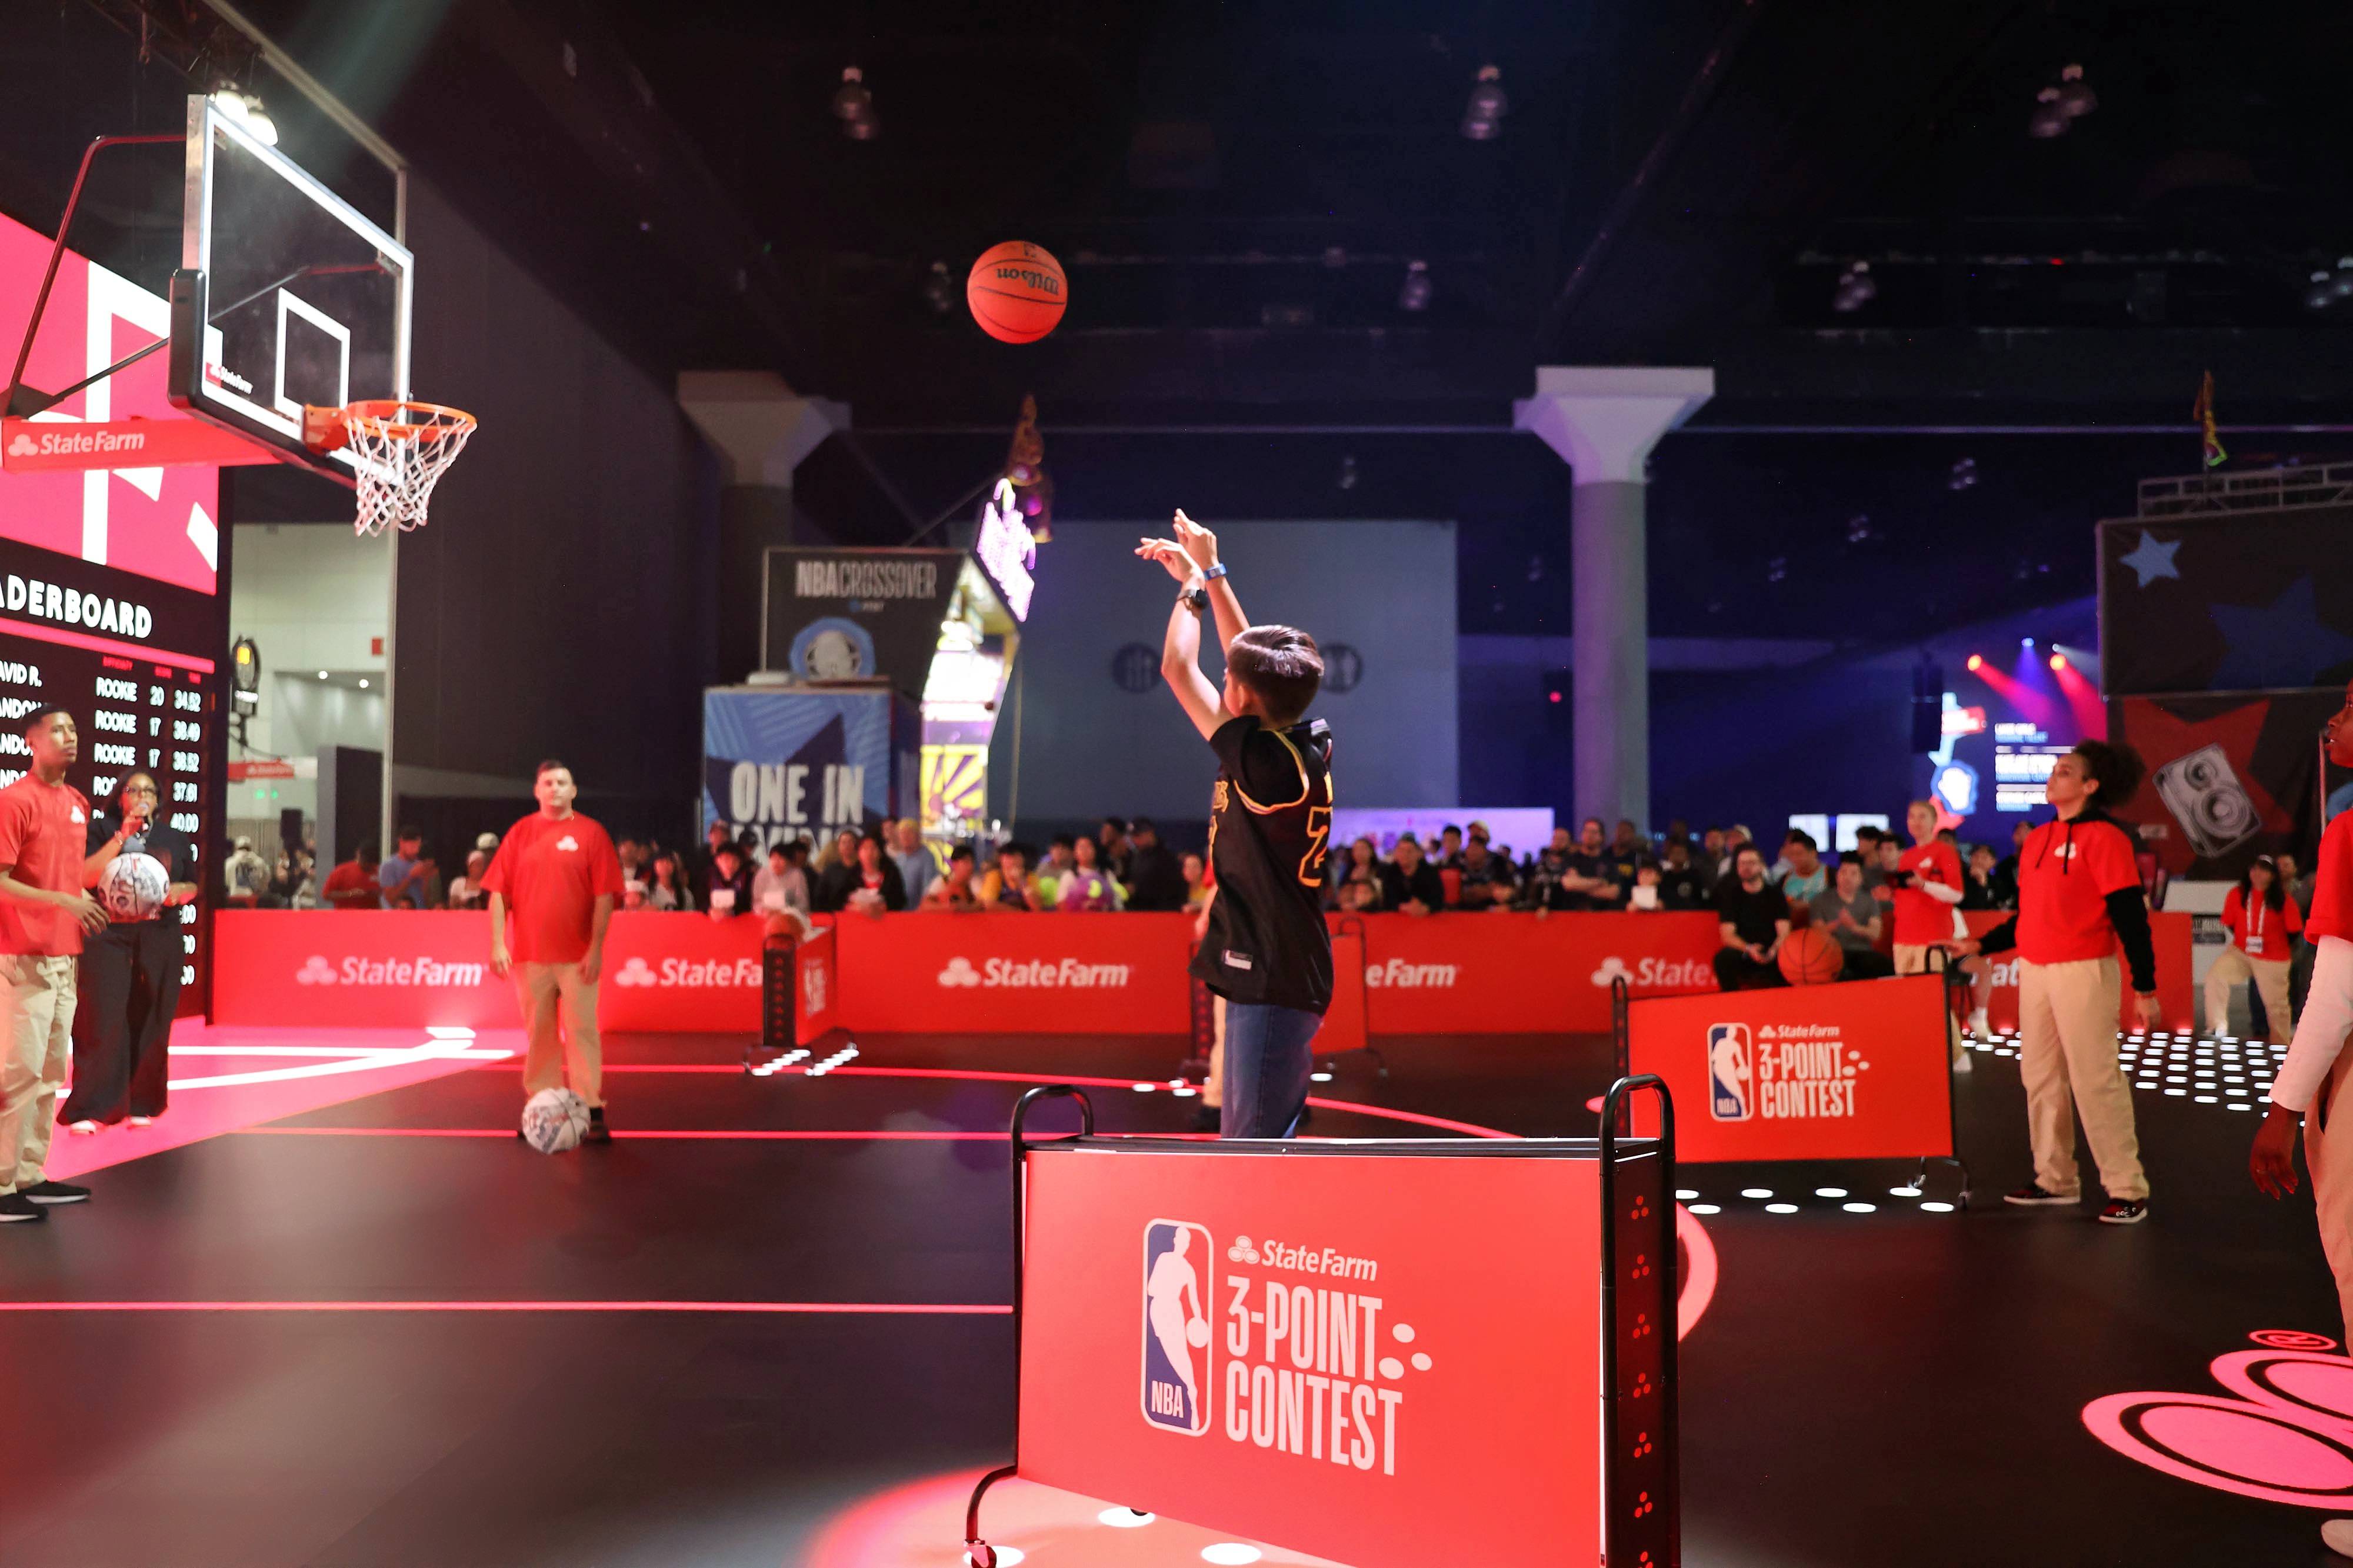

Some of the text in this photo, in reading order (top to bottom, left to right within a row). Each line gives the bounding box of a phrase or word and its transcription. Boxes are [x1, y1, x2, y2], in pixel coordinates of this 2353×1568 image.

[997, 268, 1058, 295] Wilson
[0, 574, 152, 639] DERBOARD
[29, 665, 42, 687] R.
[96, 676, 138, 702] ROOKIE
[149, 685, 165, 706] 20
[95, 709, 137, 734] ROOKIE
[149, 717, 161, 737] 17
[94, 742, 136, 766] ROOKIE
[148, 748, 161, 769] 17
[729, 761, 865, 824] ONE IN
[170, 813, 199, 833] 40.00
[1758, 1042, 1844, 1080] 3-POINT
[1760, 1079, 1855, 1118] CONTEST
[1227, 1275, 1382, 1381] 3-POINT
[1151, 1380, 1184, 1418] NBA
[1226, 1360, 1403, 1476] CONTEST
